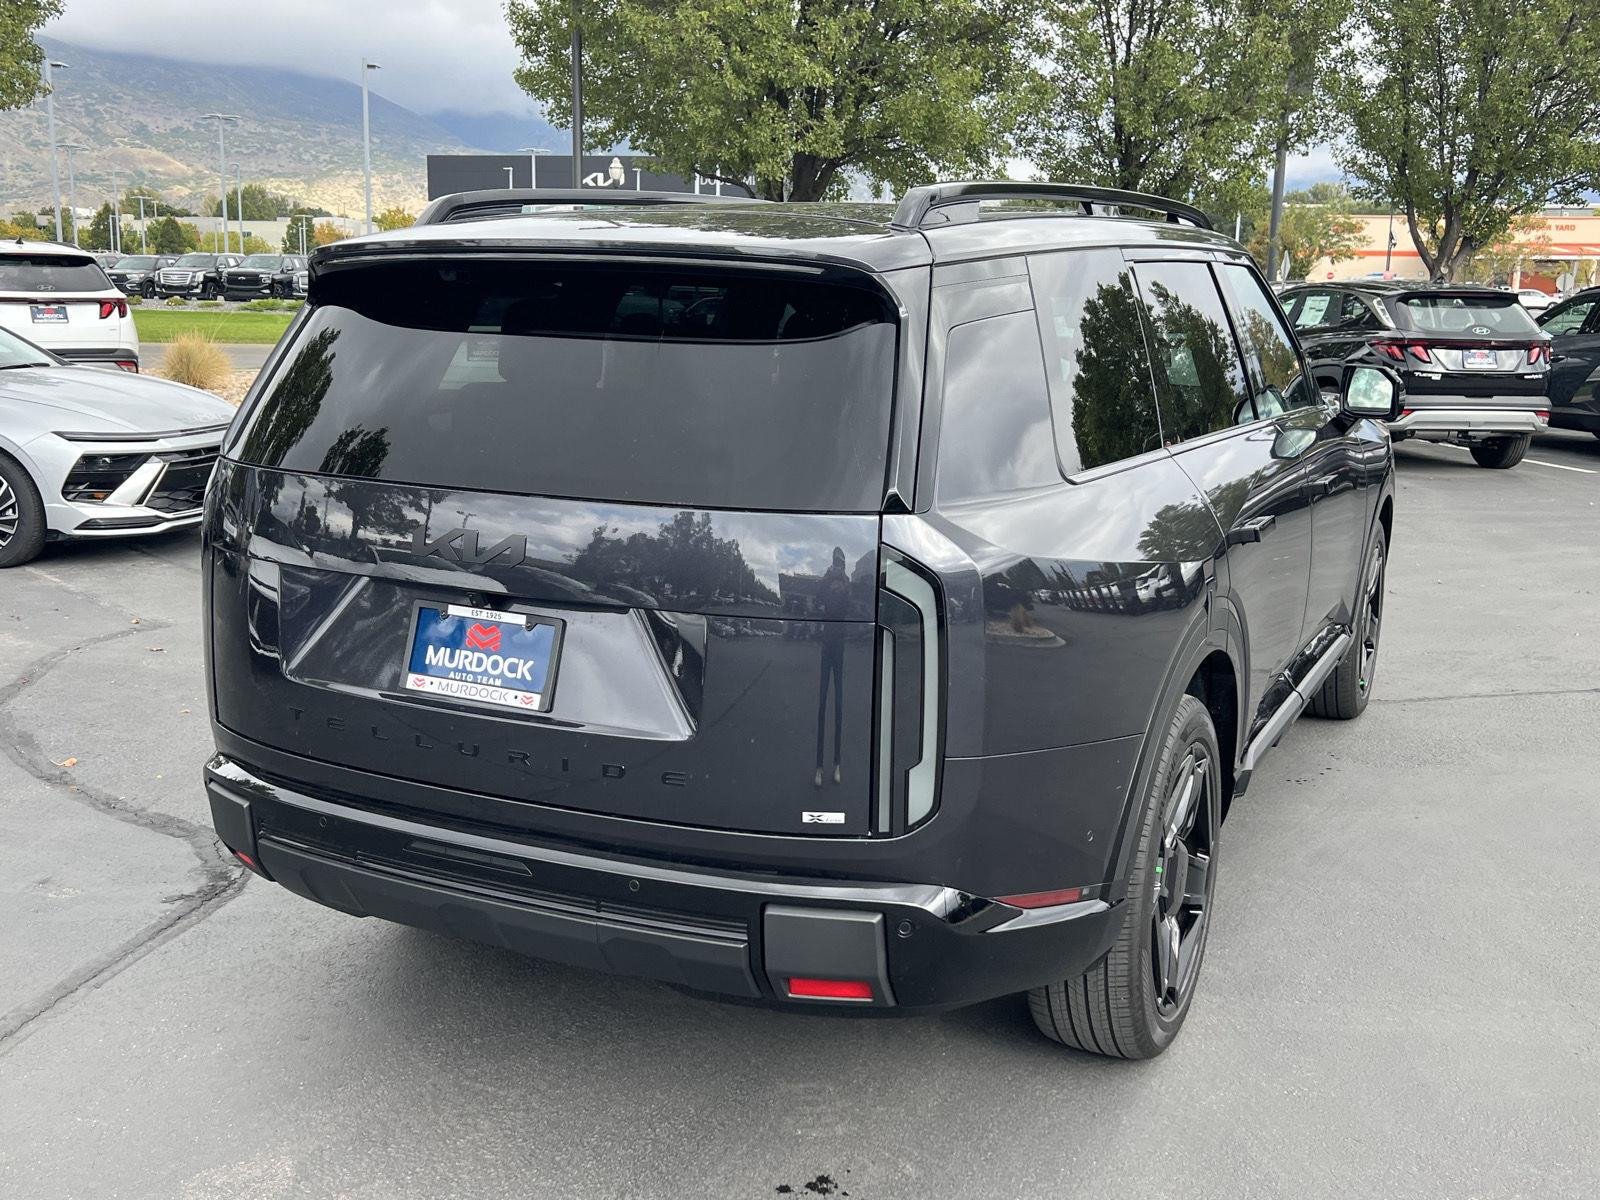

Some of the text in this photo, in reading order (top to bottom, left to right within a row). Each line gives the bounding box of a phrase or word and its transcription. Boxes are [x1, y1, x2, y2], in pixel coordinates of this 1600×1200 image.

[411, 524, 527, 568] KIA
[486, 611, 502, 620] 1925
[425, 645, 534, 681] MURDOCK
[437, 681, 509, 702] MURDOCK
[448, 670, 502, 686] AUTO TEAM
[287, 705, 687, 786] TELLURIDE
